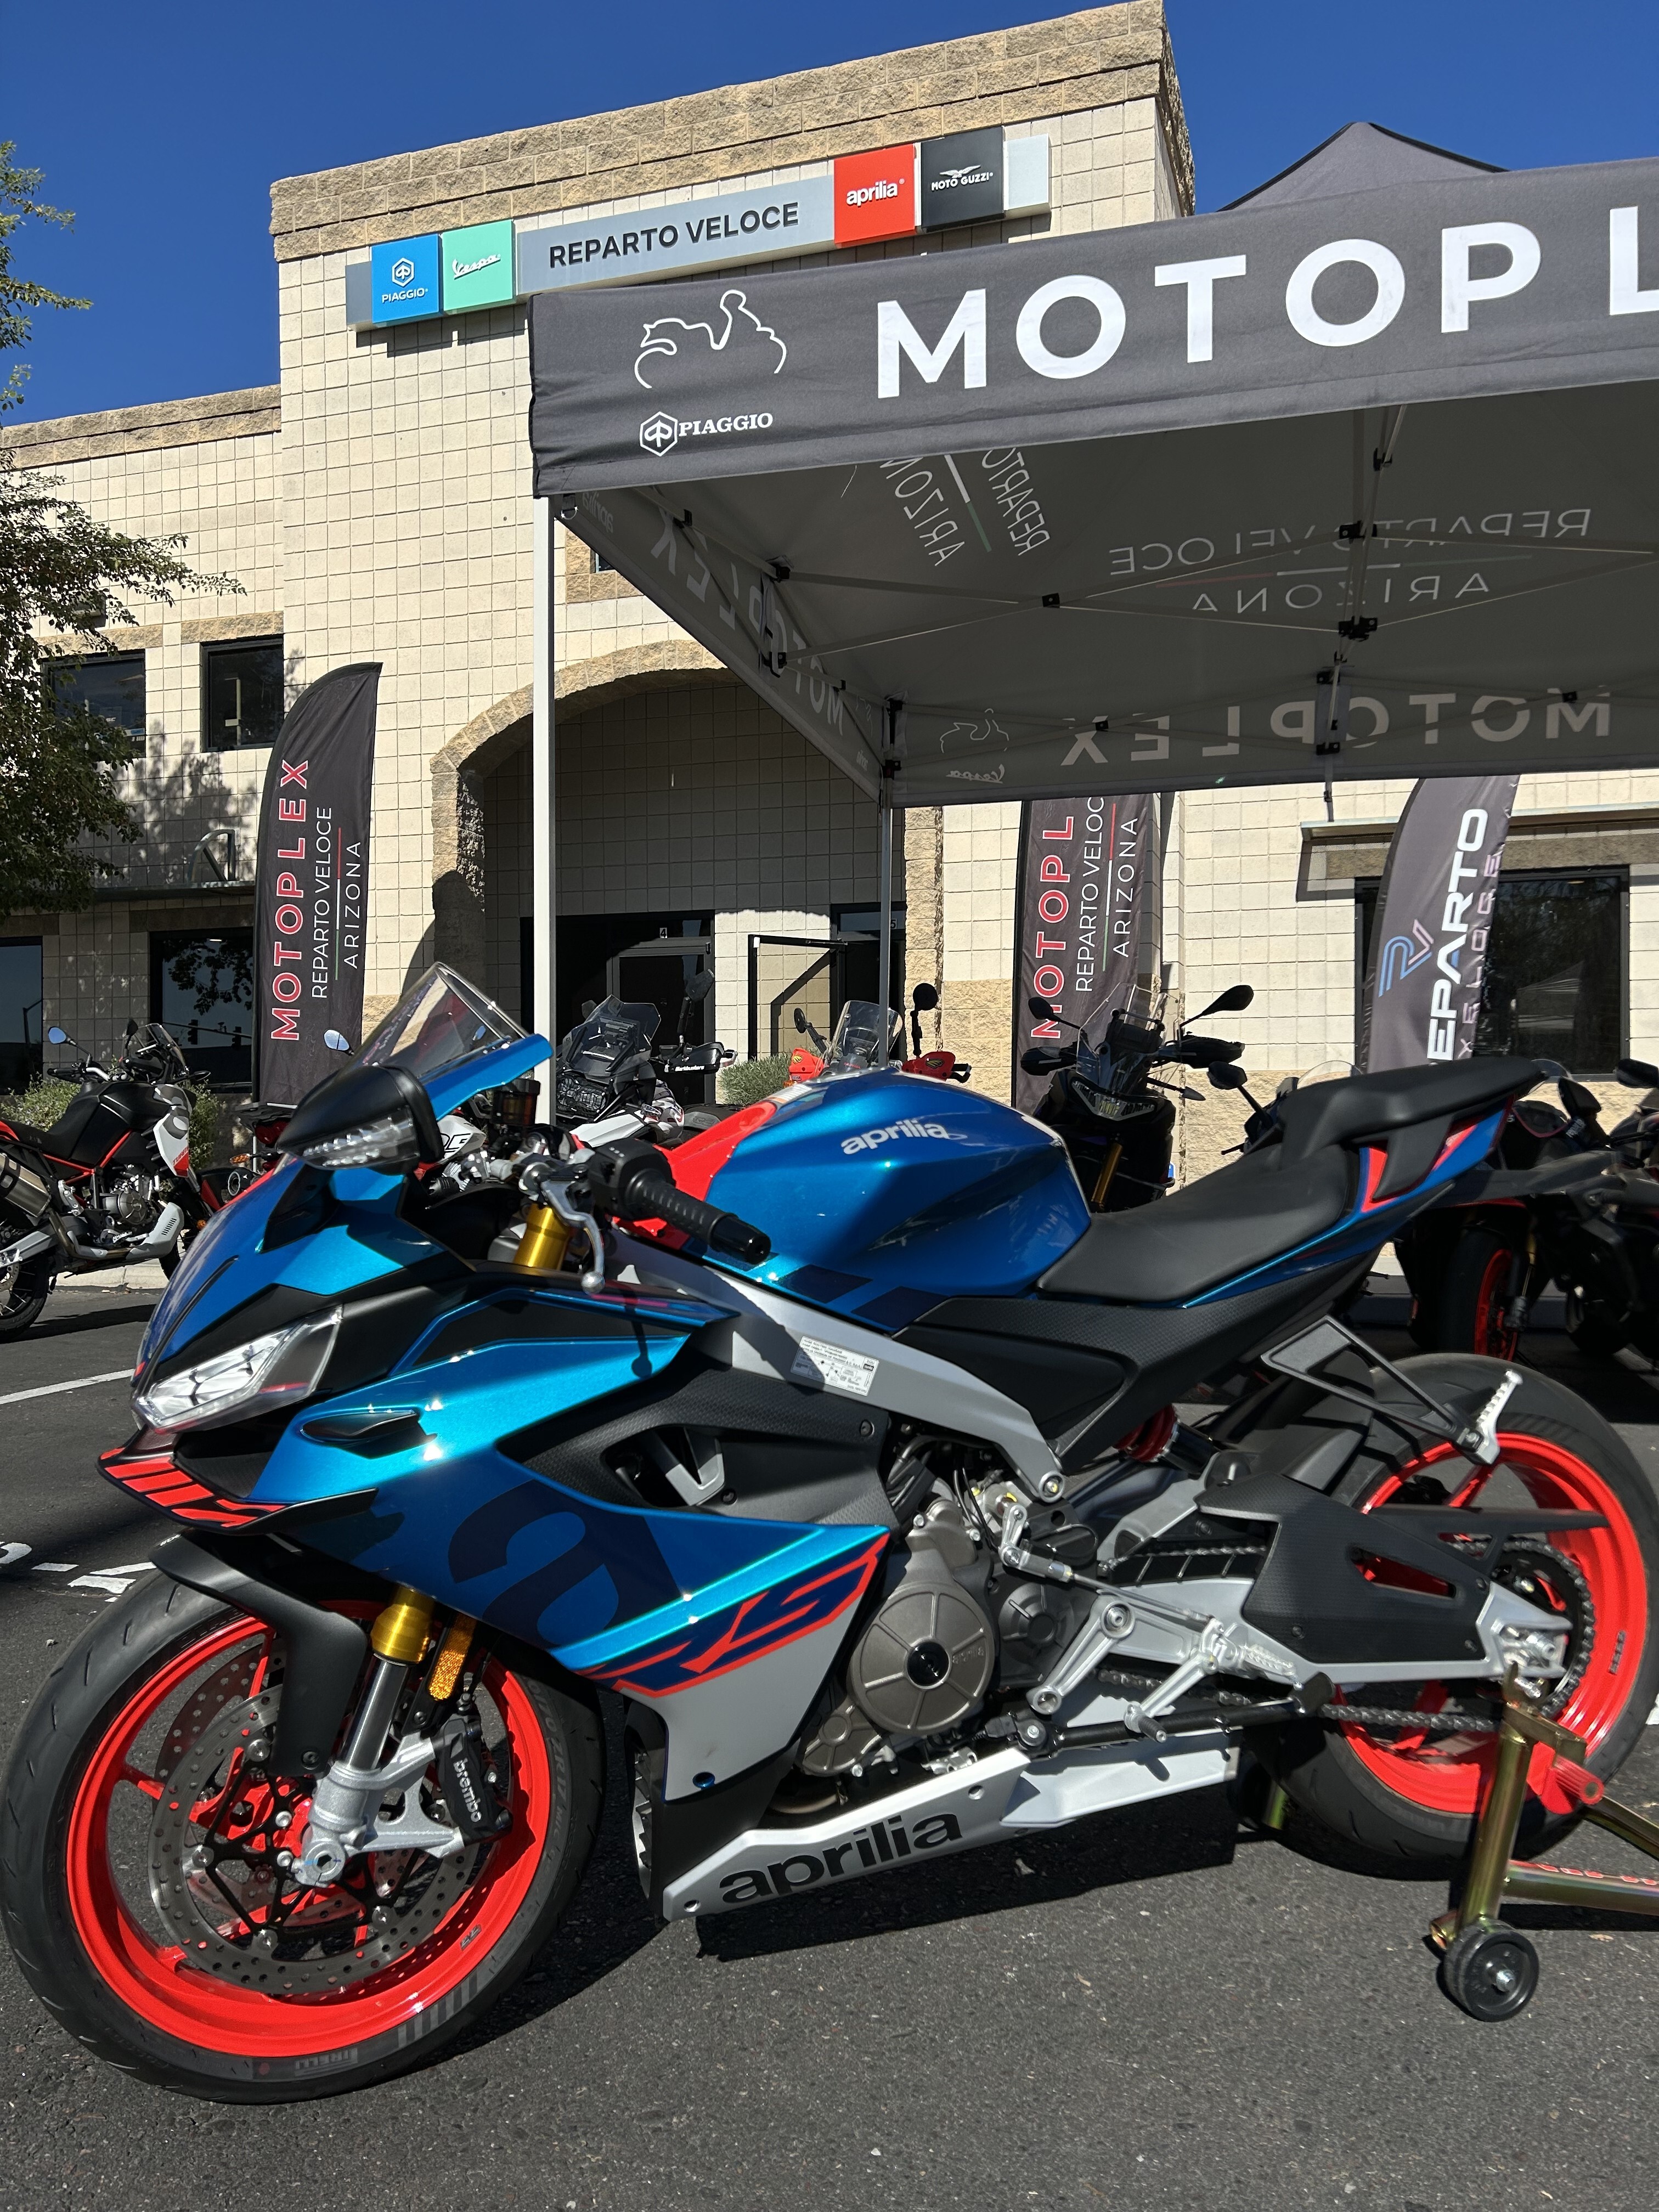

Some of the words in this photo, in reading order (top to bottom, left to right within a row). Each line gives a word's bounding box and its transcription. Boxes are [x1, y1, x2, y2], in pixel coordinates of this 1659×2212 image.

[846, 180, 898, 207] aprilia
[931, 178, 958, 191] MOTO
[961, 172, 989, 185] GUZZI
[452, 255, 500, 280] Vespa
[550, 225, 679, 268] REPARTO
[686, 202, 799, 244] VELOCE
[382, 287, 426, 303] PIAGGIO
[878, 205, 1659, 399] MOTOPL
[678, 412, 773, 437] PIAGGIO
[315, 806, 332, 894] VELOCE
[271, 759, 308, 1041] MOTOPLEX
[343, 841, 361, 969] ARIZONA
[1113, 817, 1138, 957] ARIZONA
[312, 898, 330, 999] REPARTO
[661, 928, 666, 938] 4
[1076, 883, 1099, 992] REPARTO
[840, 1120, 949, 1155] aprilia
[453, 1758, 482, 1822] brembo
[718, 1813, 962, 1906] aprilia
